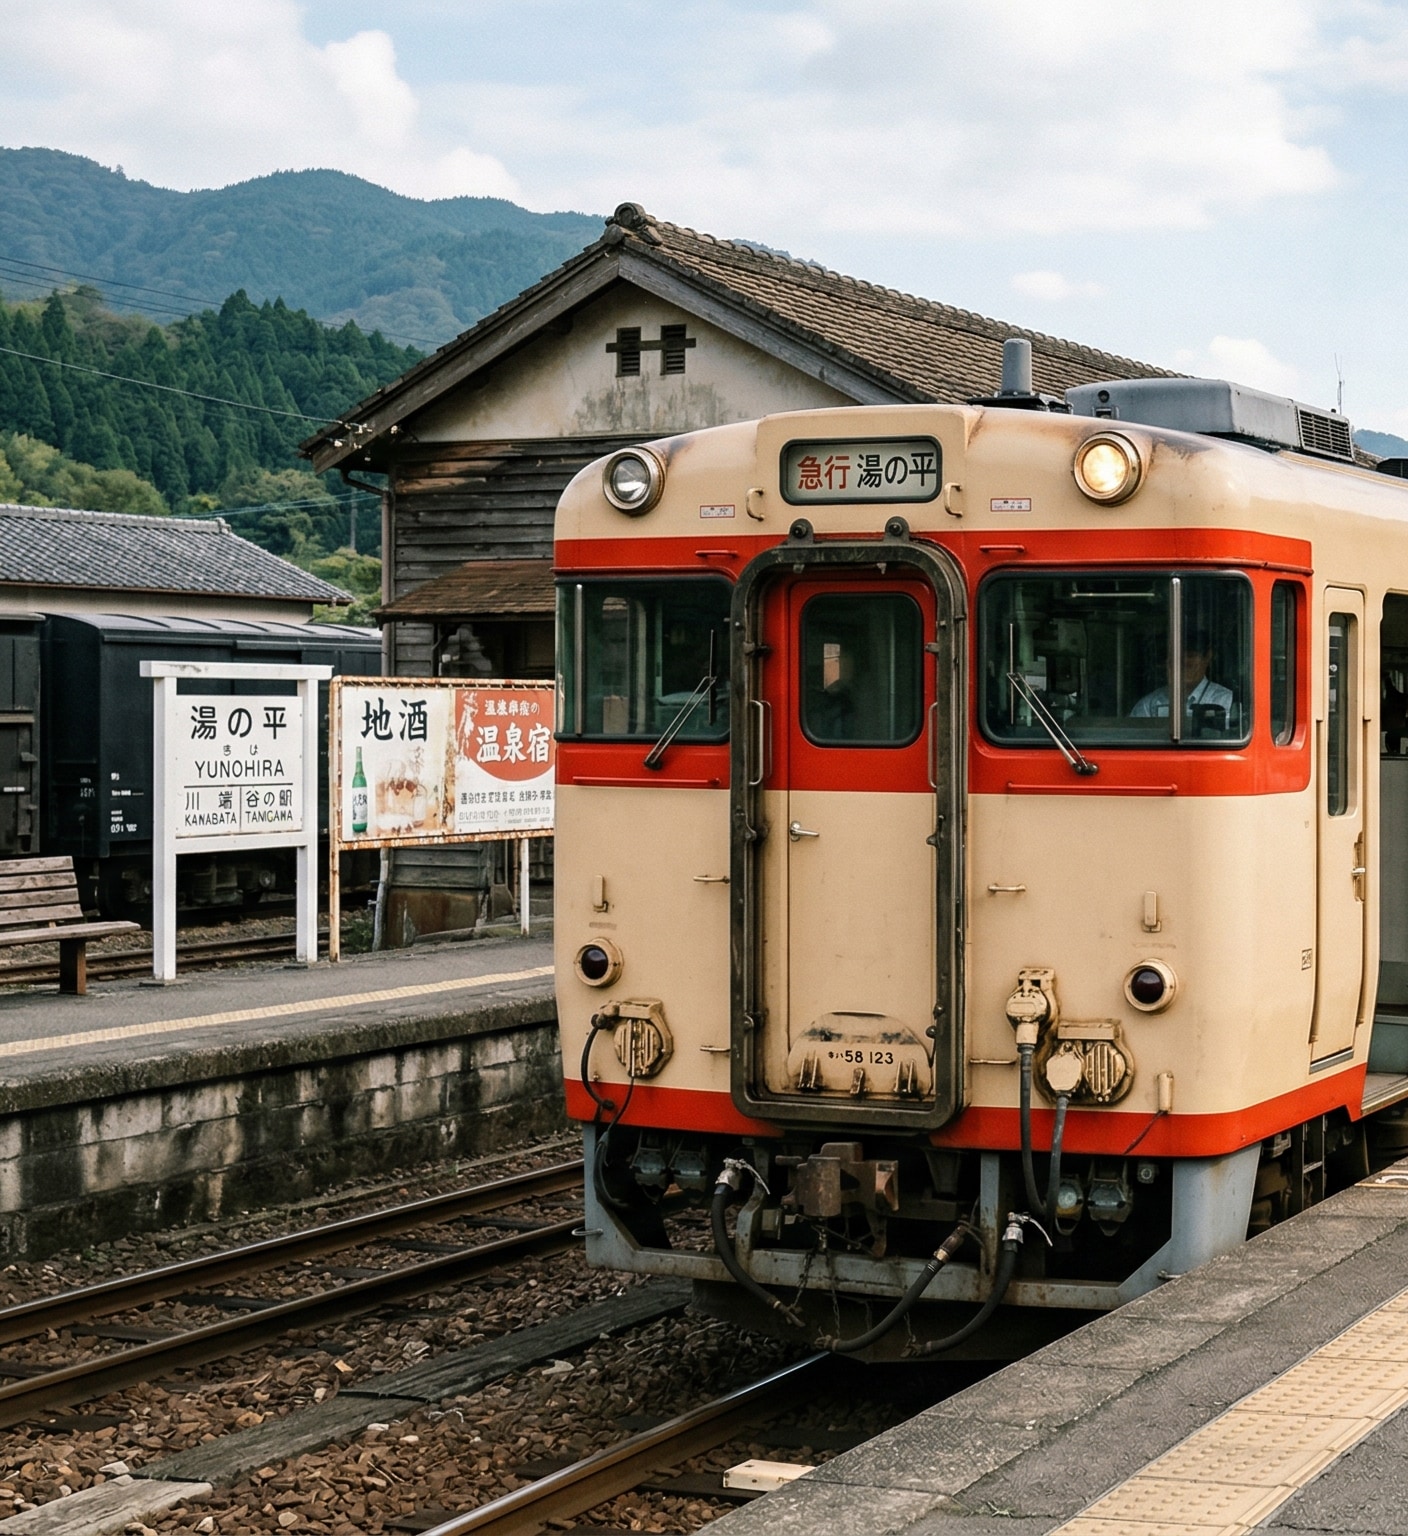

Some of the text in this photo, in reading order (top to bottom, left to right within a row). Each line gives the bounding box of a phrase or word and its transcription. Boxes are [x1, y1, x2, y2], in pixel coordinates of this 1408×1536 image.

[797, 452, 937, 490] 急行 湯の平
[190, 705, 287, 740] 湯の平
[360, 697, 428, 742] 地酒
[476, 722, 551, 764] 温泉宿
[194, 759, 285, 779] YUNOHIRA
[869, 1051, 894, 1065] 123
